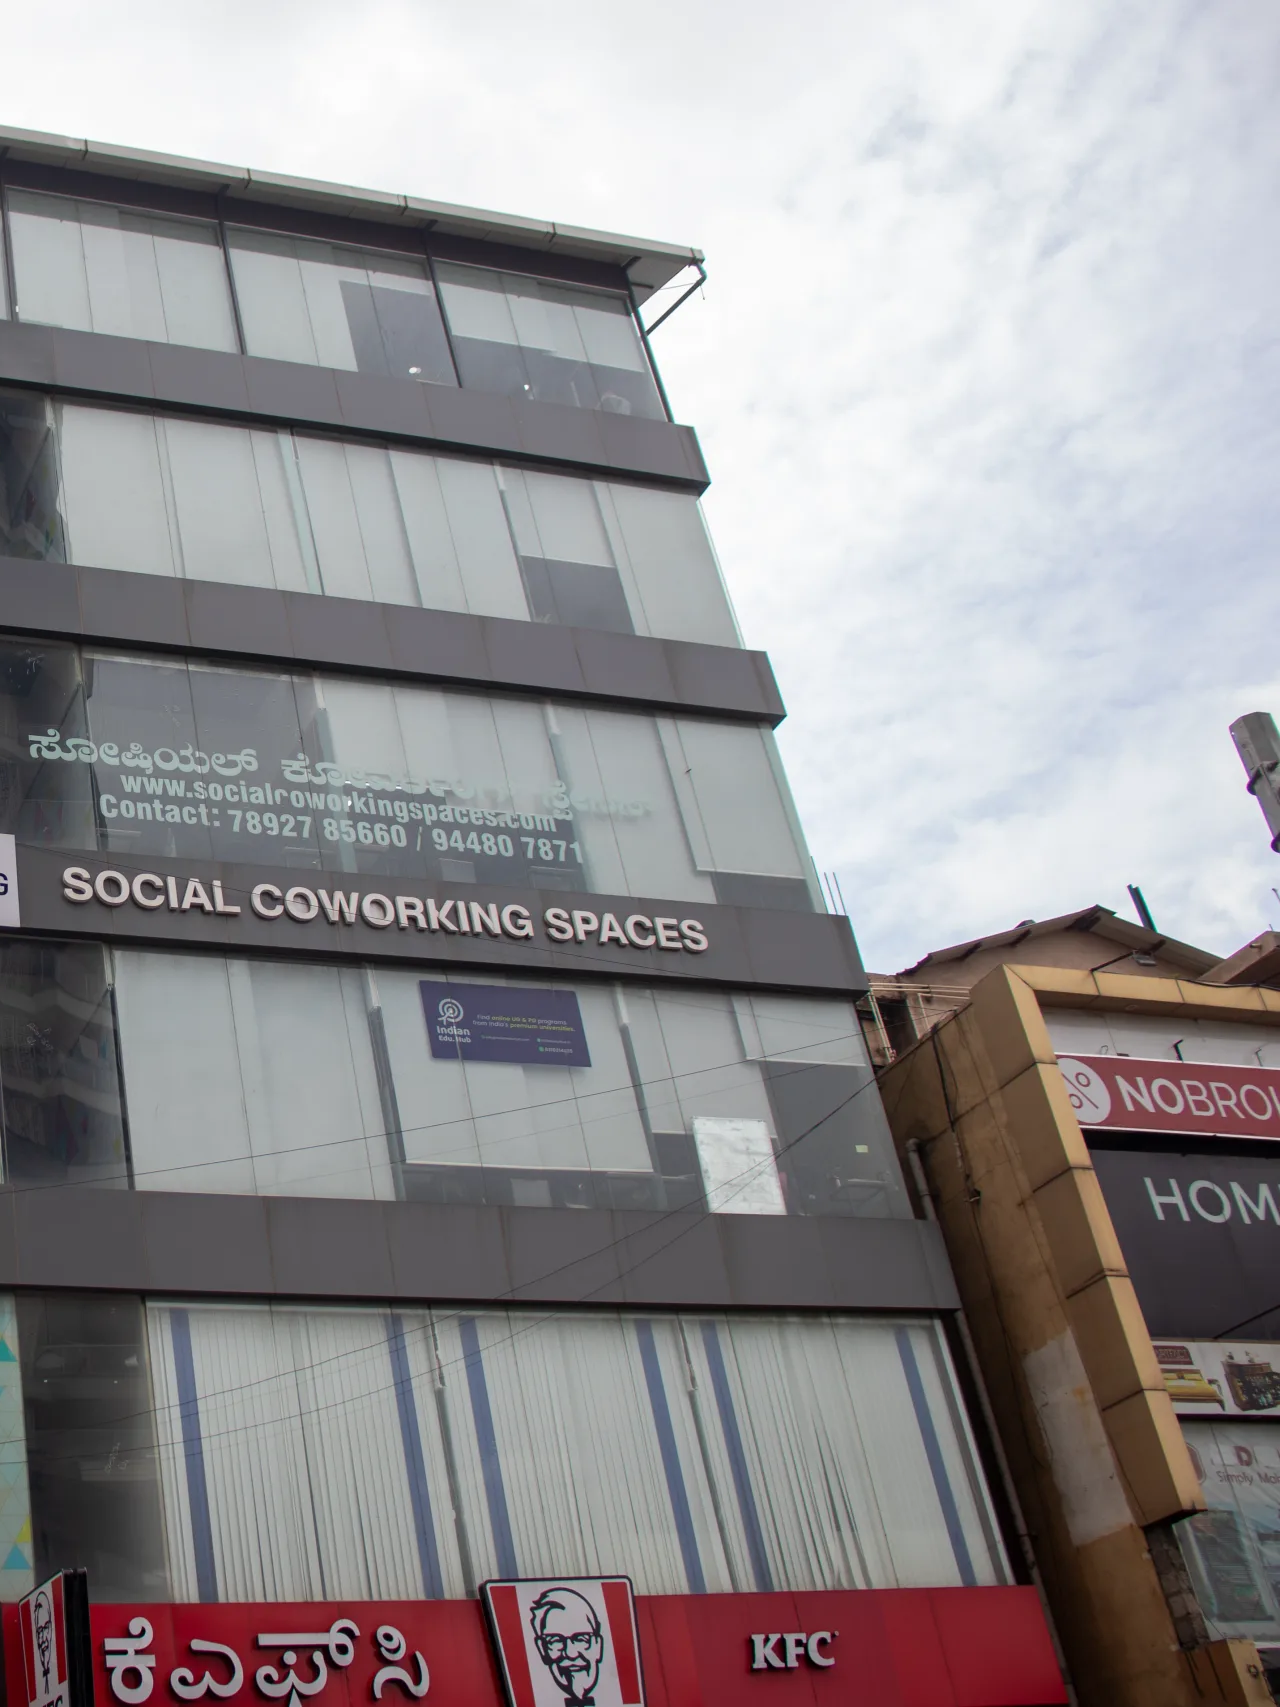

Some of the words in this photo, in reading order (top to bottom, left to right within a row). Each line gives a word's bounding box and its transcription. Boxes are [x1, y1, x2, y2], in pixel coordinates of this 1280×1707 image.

[99, 794, 220, 827] Contact:
[227, 810, 312, 839] 78927
[323, 817, 407, 848] 85660
[432, 828, 514, 857] 94480
[62, 866, 241, 914] SOCIAL
[251, 883, 534, 940] COWORKING
[544, 907, 709, 952] SPACES
[436, 1025, 471, 1036] Indian
[1143, 1177, 1280, 1226] HOM
[1216, 1470, 1253, 1485] Simply
[750, 1630, 836, 1670] KFC
